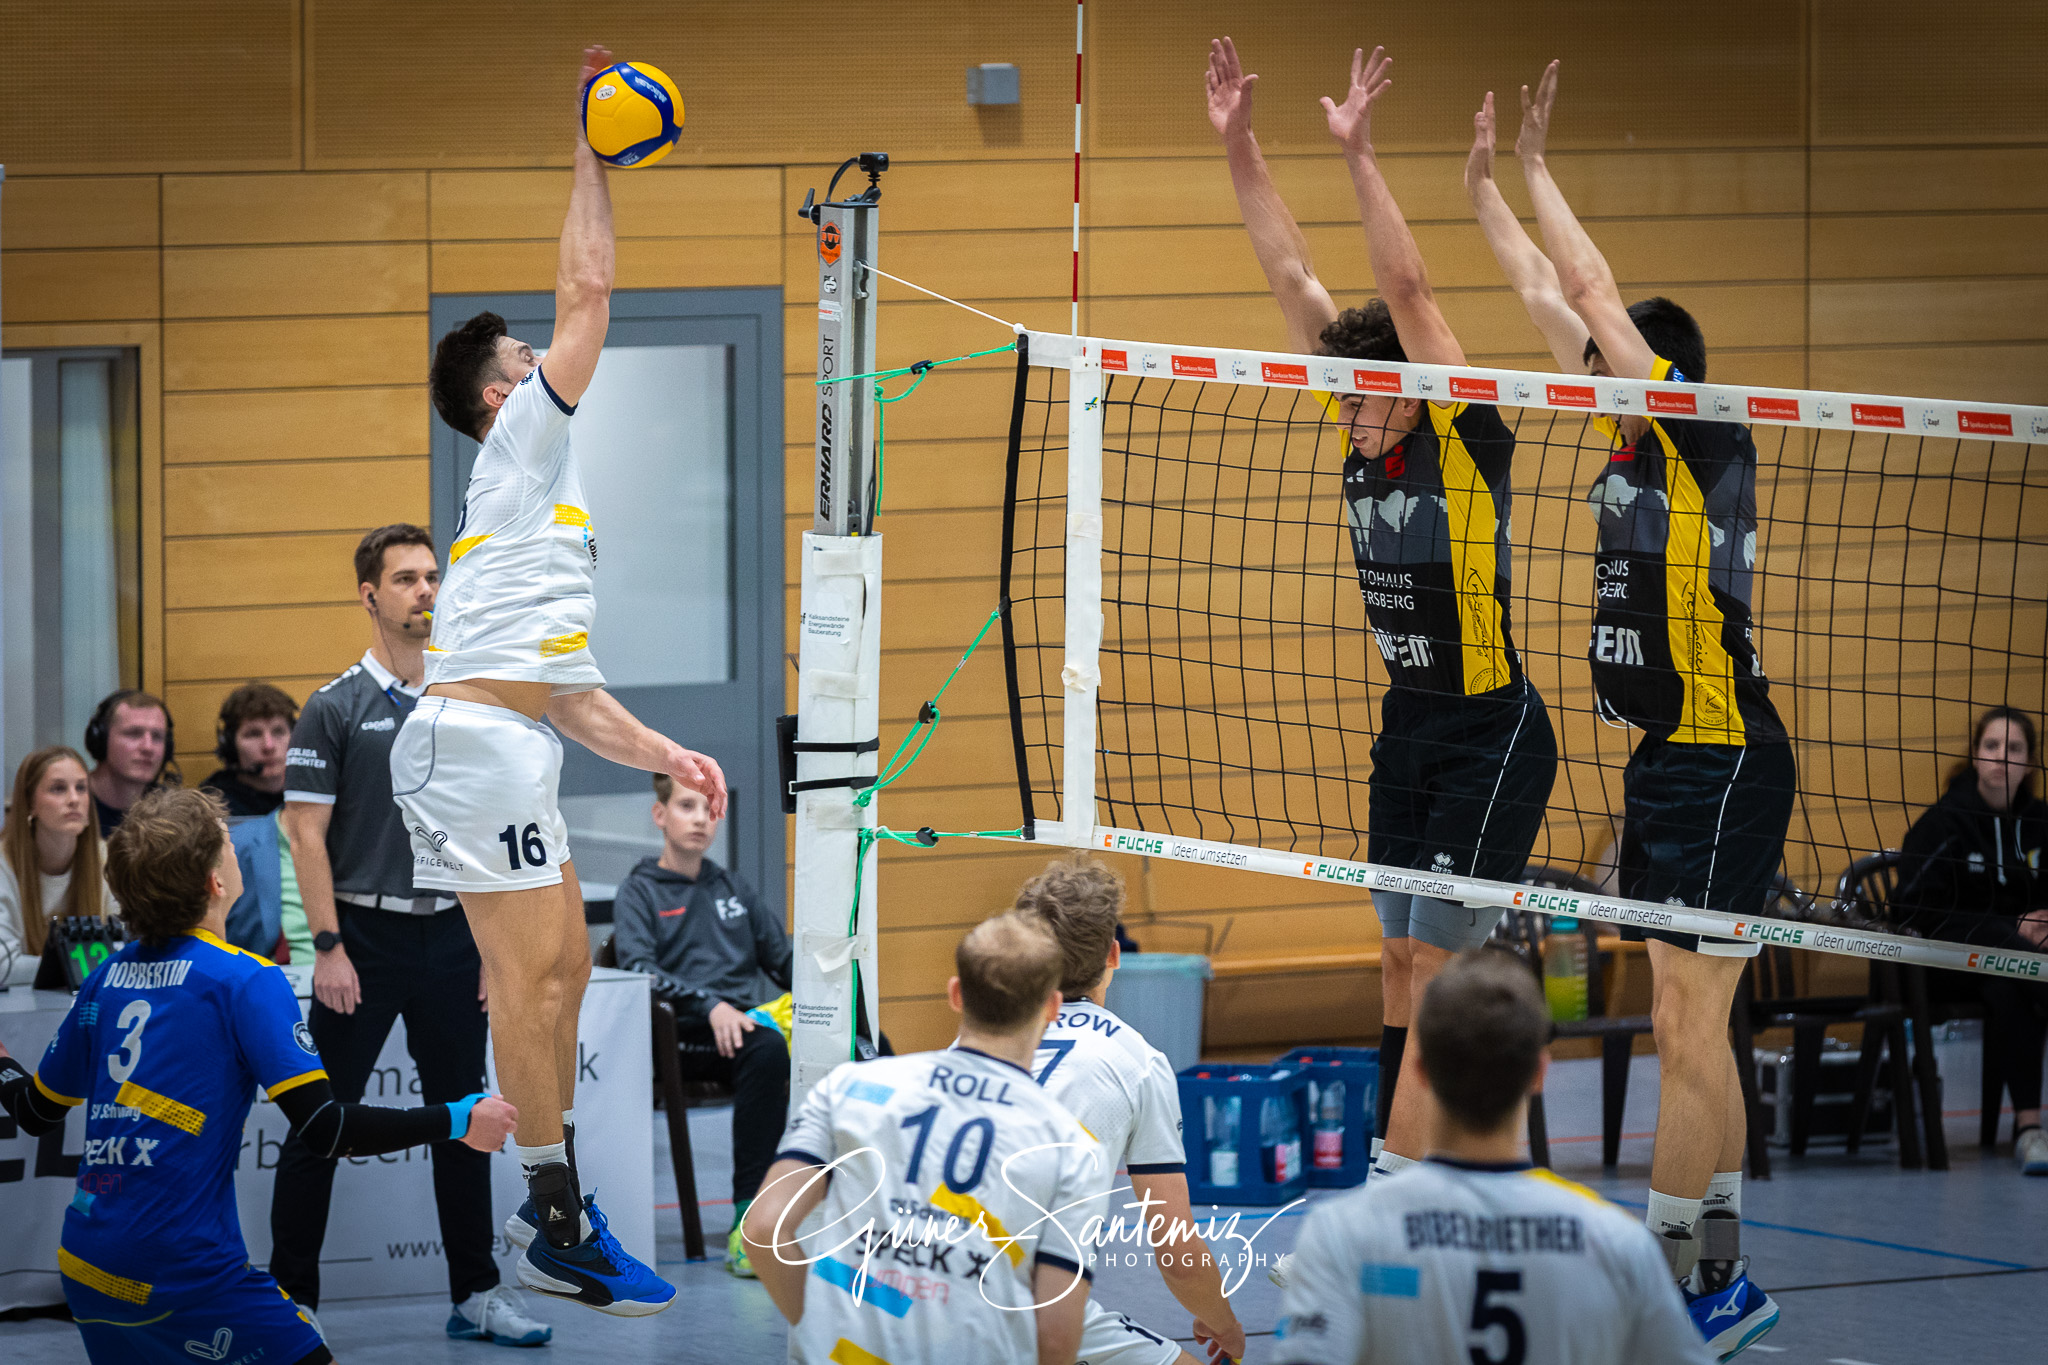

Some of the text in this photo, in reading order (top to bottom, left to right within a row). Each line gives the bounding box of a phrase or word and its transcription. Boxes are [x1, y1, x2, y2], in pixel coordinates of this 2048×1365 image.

[819, 334, 835, 522] ERHARD SPORT
[1358, 569, 1413, 589] TOHAUS
[1361, 589, 1415, 610] ERSBERG
[808, 627, 841, 637] Bauberatung
[498, 822, 547, 870] 16
[1117, 835, 1247, 867] FUCHS Ideen umsetzen
[1316, 863, 1454, 896] FUCHS Ideen umsetzen
[1527, 893, 1672, 926] FUCHS Ideen umsetzen
[1750, 924, 1902, 958] FUCHS Ideen umsetzen
[103, 960, 193, 989] DOBBERTIN
[1983, 954, 2041, 976] FUCHS
[798, 1017, 831, 1027] Bauberatung
[1056, 1012, 1121, 1038] ROW
[107, 999, 152, 1083] 3
[928, 1065, 1014, 1106] ROLL
[900, 1103, 996, 1195] 10
[1466, 1269, 1528, 1365] 5
